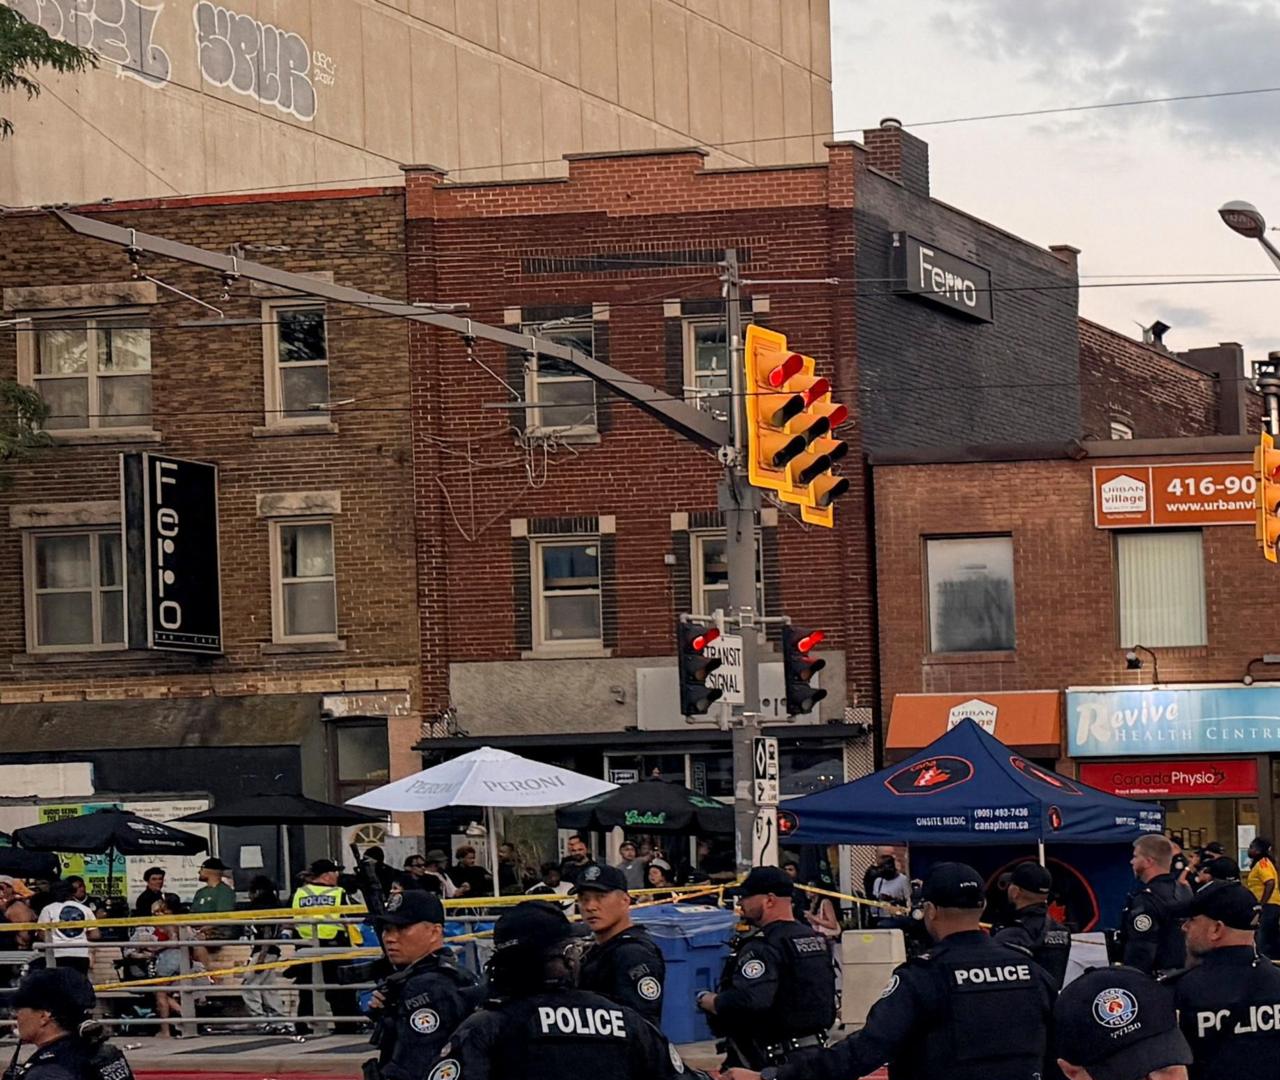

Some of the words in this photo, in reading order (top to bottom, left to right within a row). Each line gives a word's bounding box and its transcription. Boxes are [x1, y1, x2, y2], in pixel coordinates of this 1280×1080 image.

[919, 246, 976, 307] Ferro
[1102, 485, 1144, 494] URBAN
[1104, 494, 1144, 505] village
[155, 461, 182, 630] Ferro
[483, 775, 566, 792] PERONI
[916, 817, 942, 826] ONSITE
[942, 816, 966, 826] MEDIC
[300, 896, 334, 907] POLICE
[954, 964, 1031, 986] POLICE
[538, 1005, 627, 1038] POLICE
